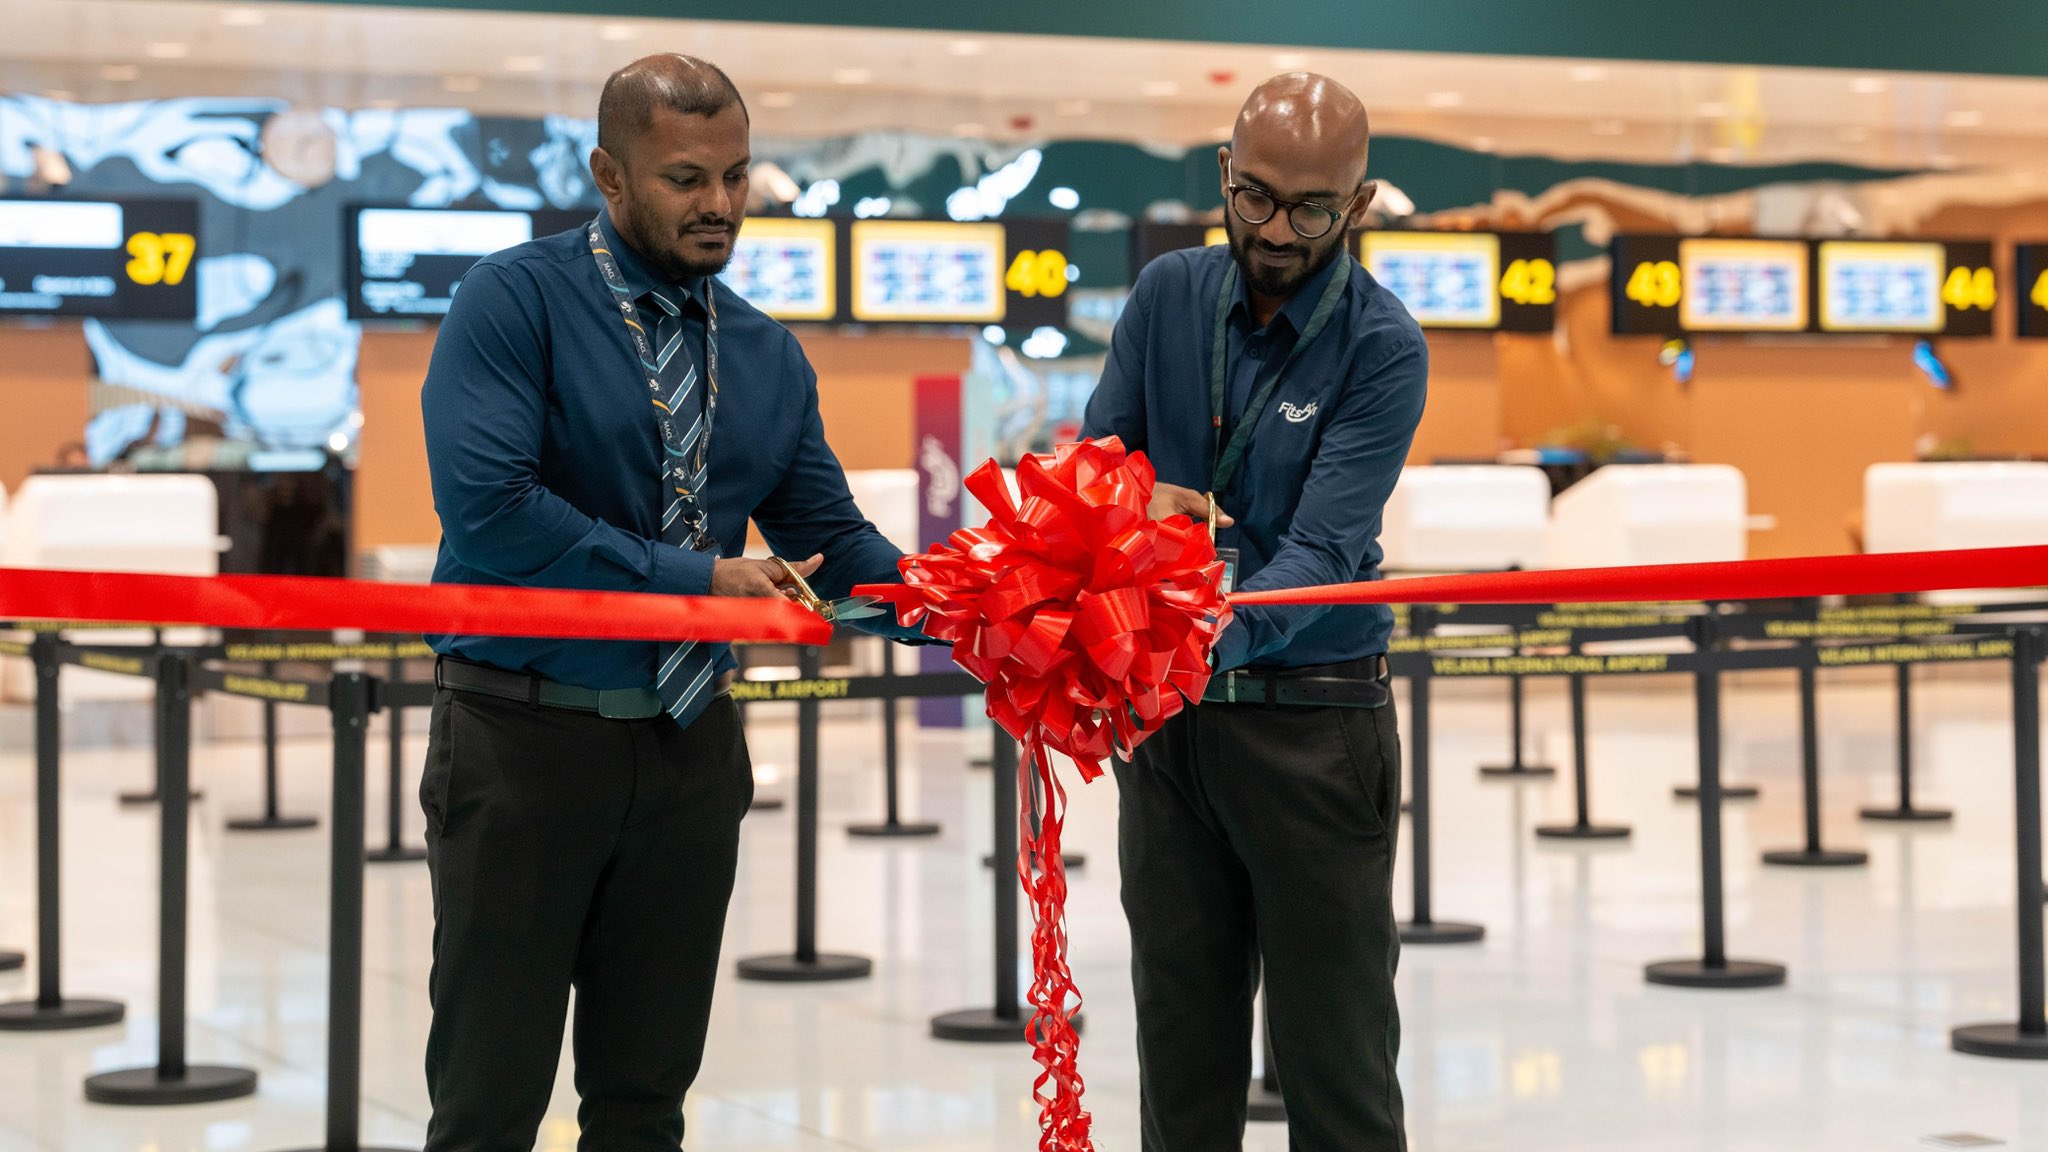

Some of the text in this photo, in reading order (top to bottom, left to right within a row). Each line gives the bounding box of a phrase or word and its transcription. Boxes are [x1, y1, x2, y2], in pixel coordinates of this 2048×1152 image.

[126, 231, 196, 286] 37
[603, 262, 614, 280] MACL
[1005, 249, 1067, 298] 40
[1500, 258, 1556, 305] 42
[1625, 261, 1682, 307] 43
[636, 335, 646, 354] MACL
[1278, 401, 1318, 423] FitsAir
[663, 420, 674, 441] MACL
[1431, 653, 1668, 675] VELANA INTERNATIONAL AIRPORT
[776, 679, 849, 699] AIRPORT
